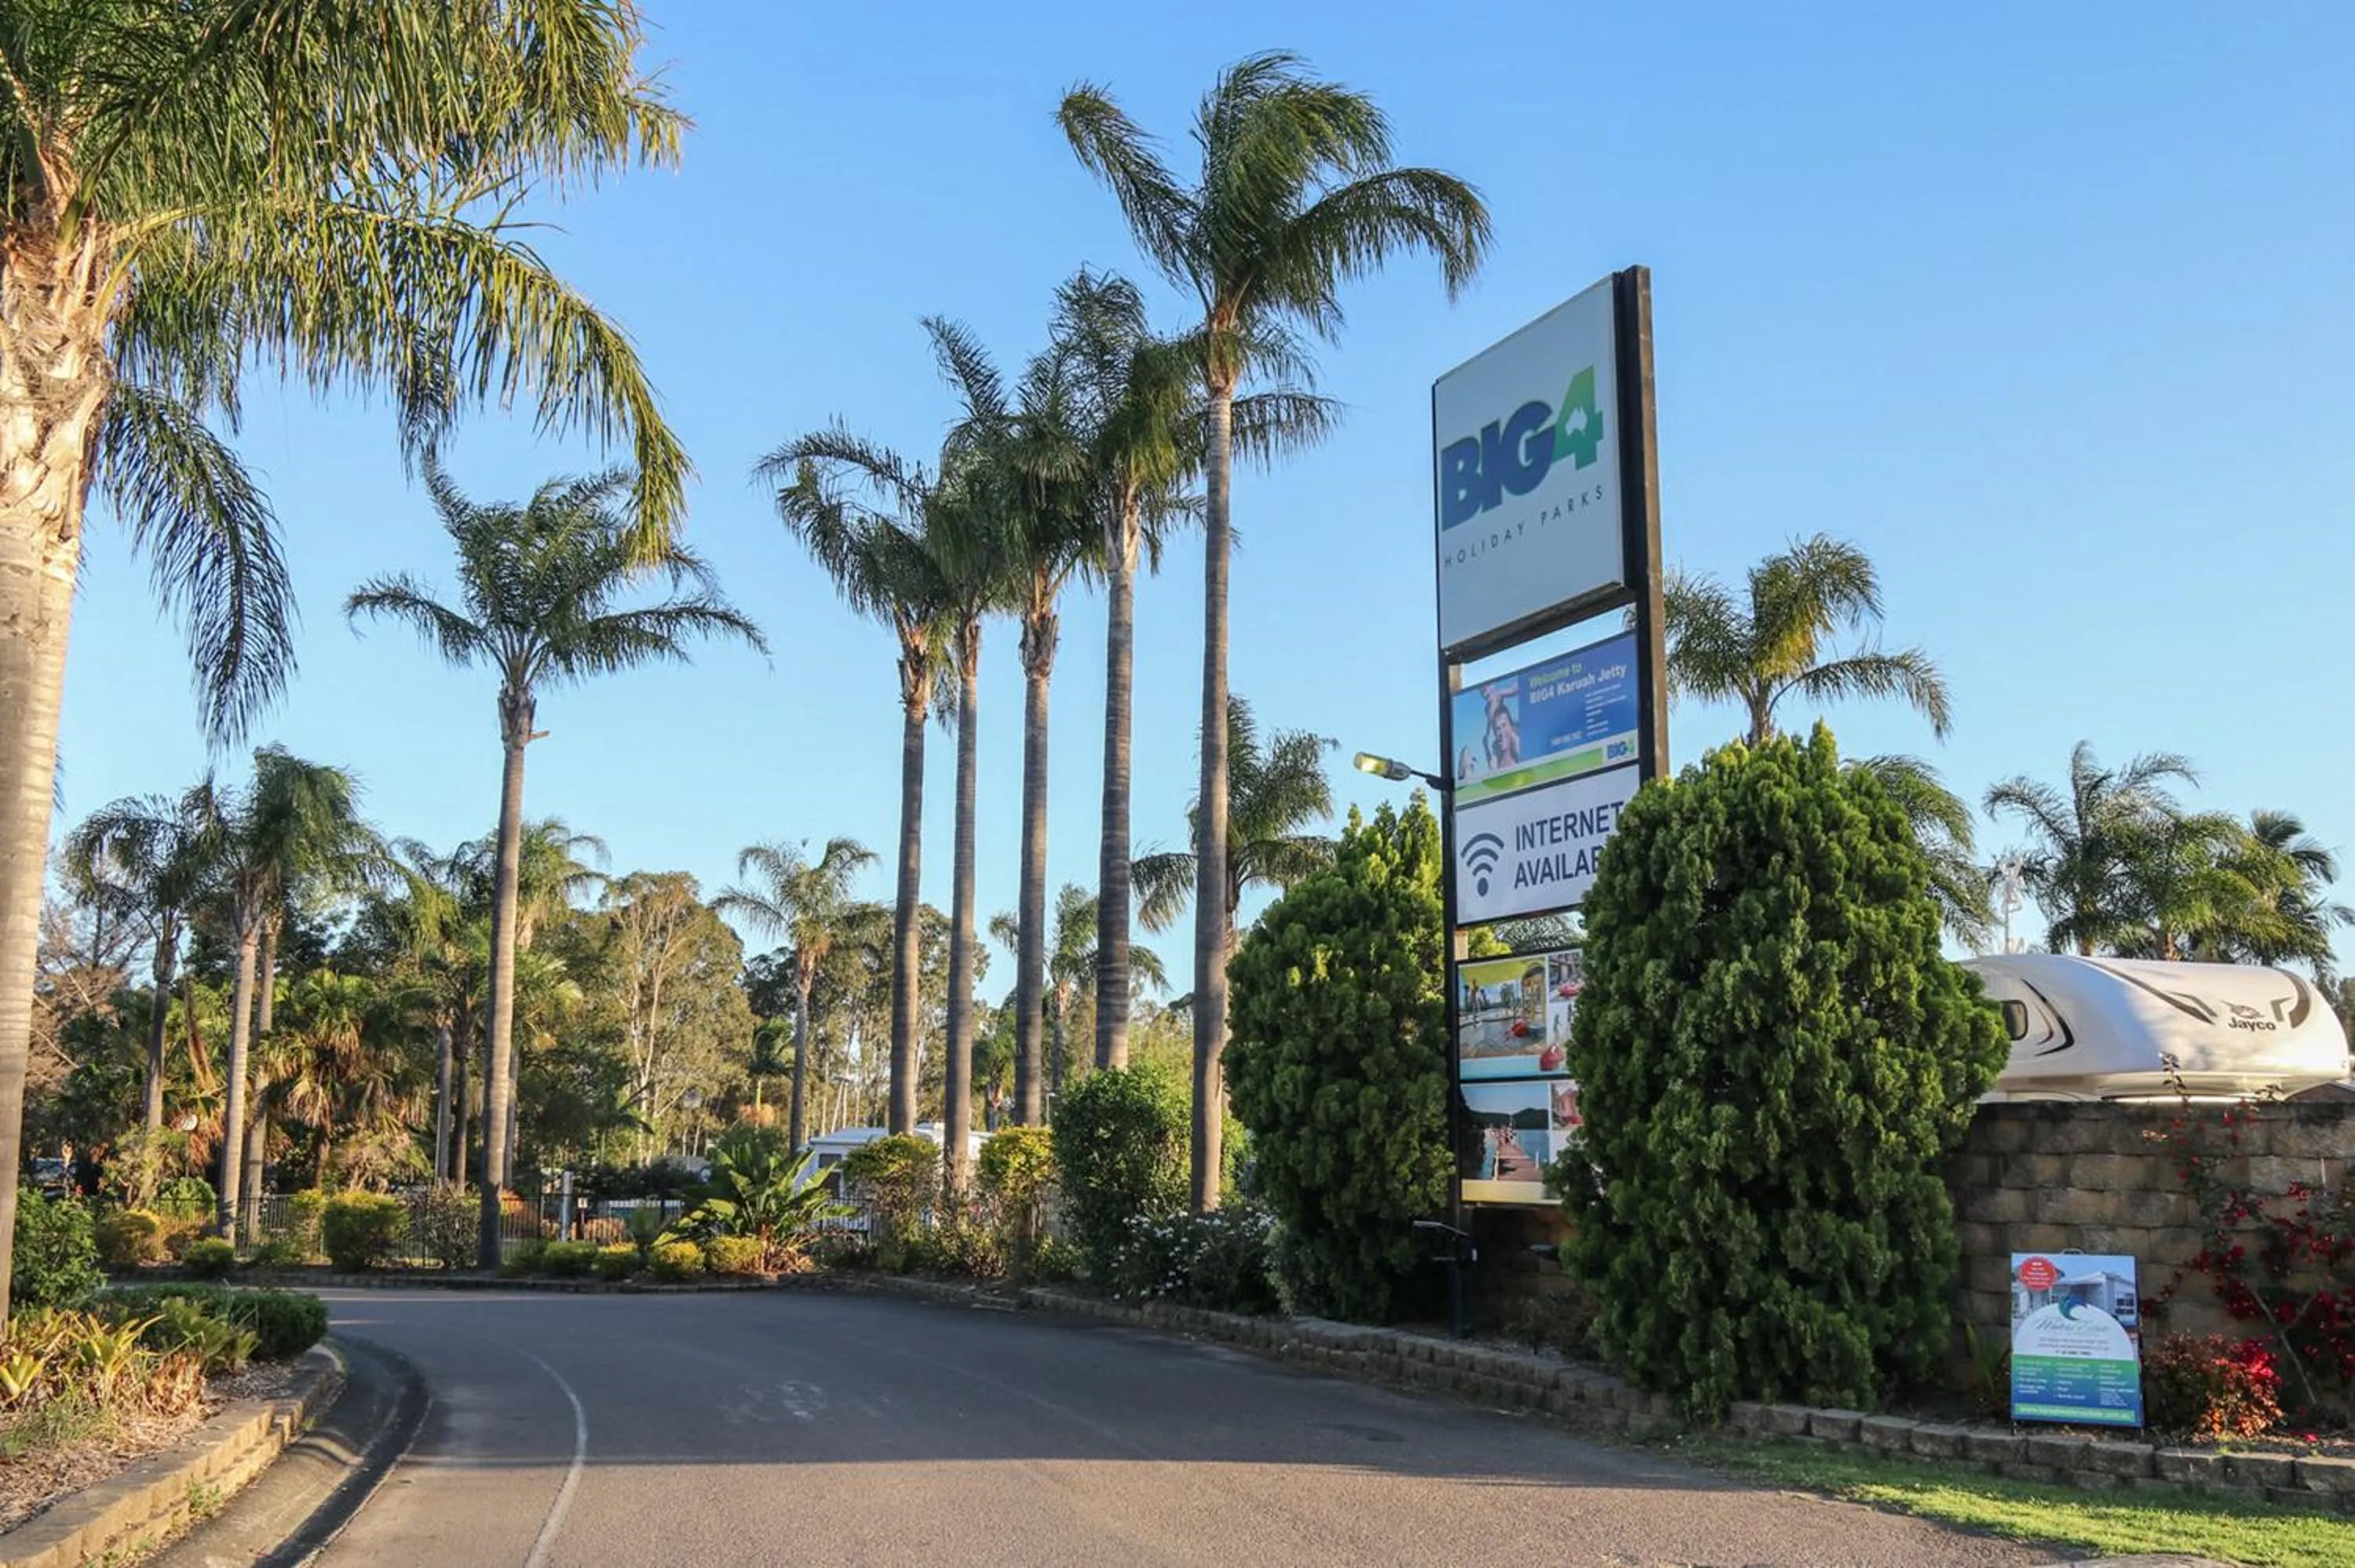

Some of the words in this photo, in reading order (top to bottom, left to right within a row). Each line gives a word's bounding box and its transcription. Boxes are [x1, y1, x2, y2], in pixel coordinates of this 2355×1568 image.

[1441, 364, 1604, 532] BIG4
[1444, 521, 1525, 567] HOLIDAY
[1540, 484, 1604, 527] PARKS
[1557, 673, 1596, 697] Karuah
[1597, 664, 1627, 683] Jetty
[1515, 800, 1624, 852] INTERNET
[2228, 1016, 2276, 1032] Jayco
